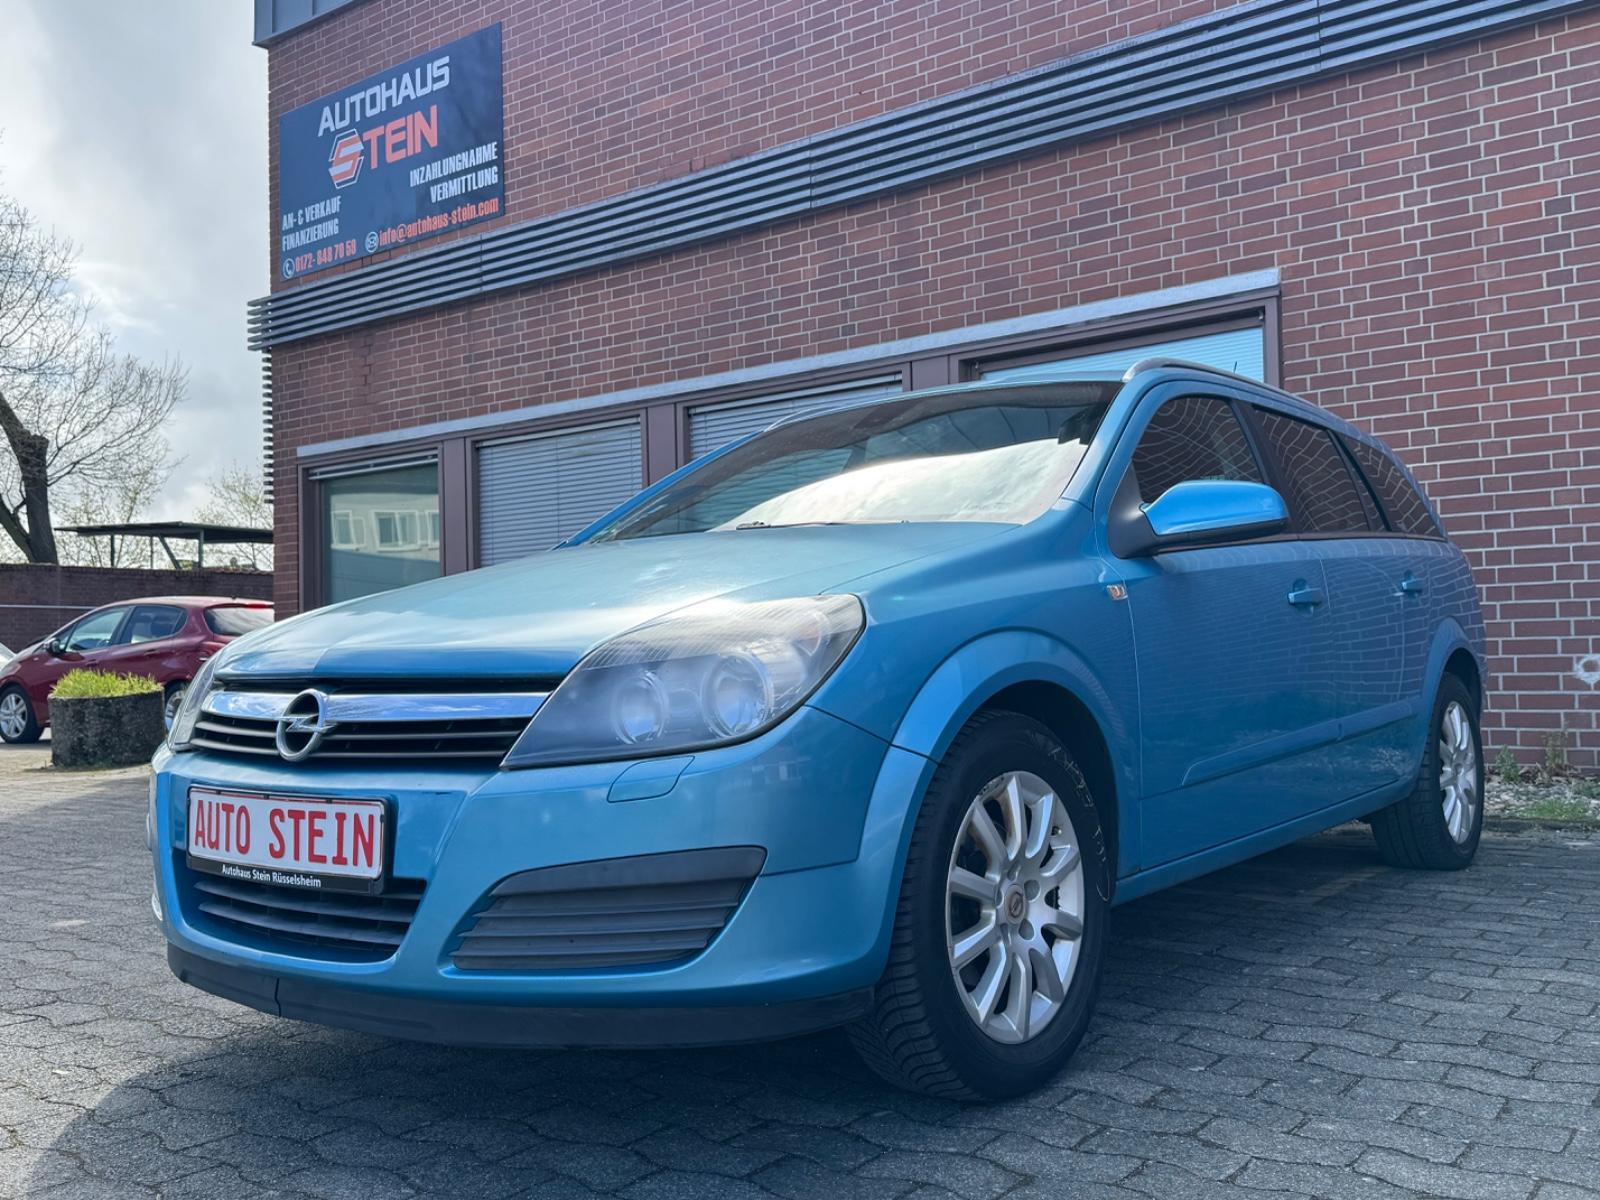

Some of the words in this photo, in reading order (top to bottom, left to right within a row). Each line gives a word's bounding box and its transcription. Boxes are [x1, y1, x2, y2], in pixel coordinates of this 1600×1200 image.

[317, 55, 450, 137] AUTOHAUS
[328, 104, 438, 190] STEIN
[409, 141, 498, 187] INZAHLUNGNAHME
[430, 166, 498, 203] VERMITTLUNG
[282, 212, 297, 231] AN-
[304, 195, 341, 223] VERKAUF
[282, 218, 339, 252] FINANZIERUNG
[379, 197, 499, 246] info@autohaus-stein.com
[195, 799, 250, 855] AUTO
[268, 808, 374, 868] STEIN
[222, 864, 251, 879] Autohaus
[252, 869, 271, 882] Stein
[272, 872, 322, 888] Rüsselsheim
